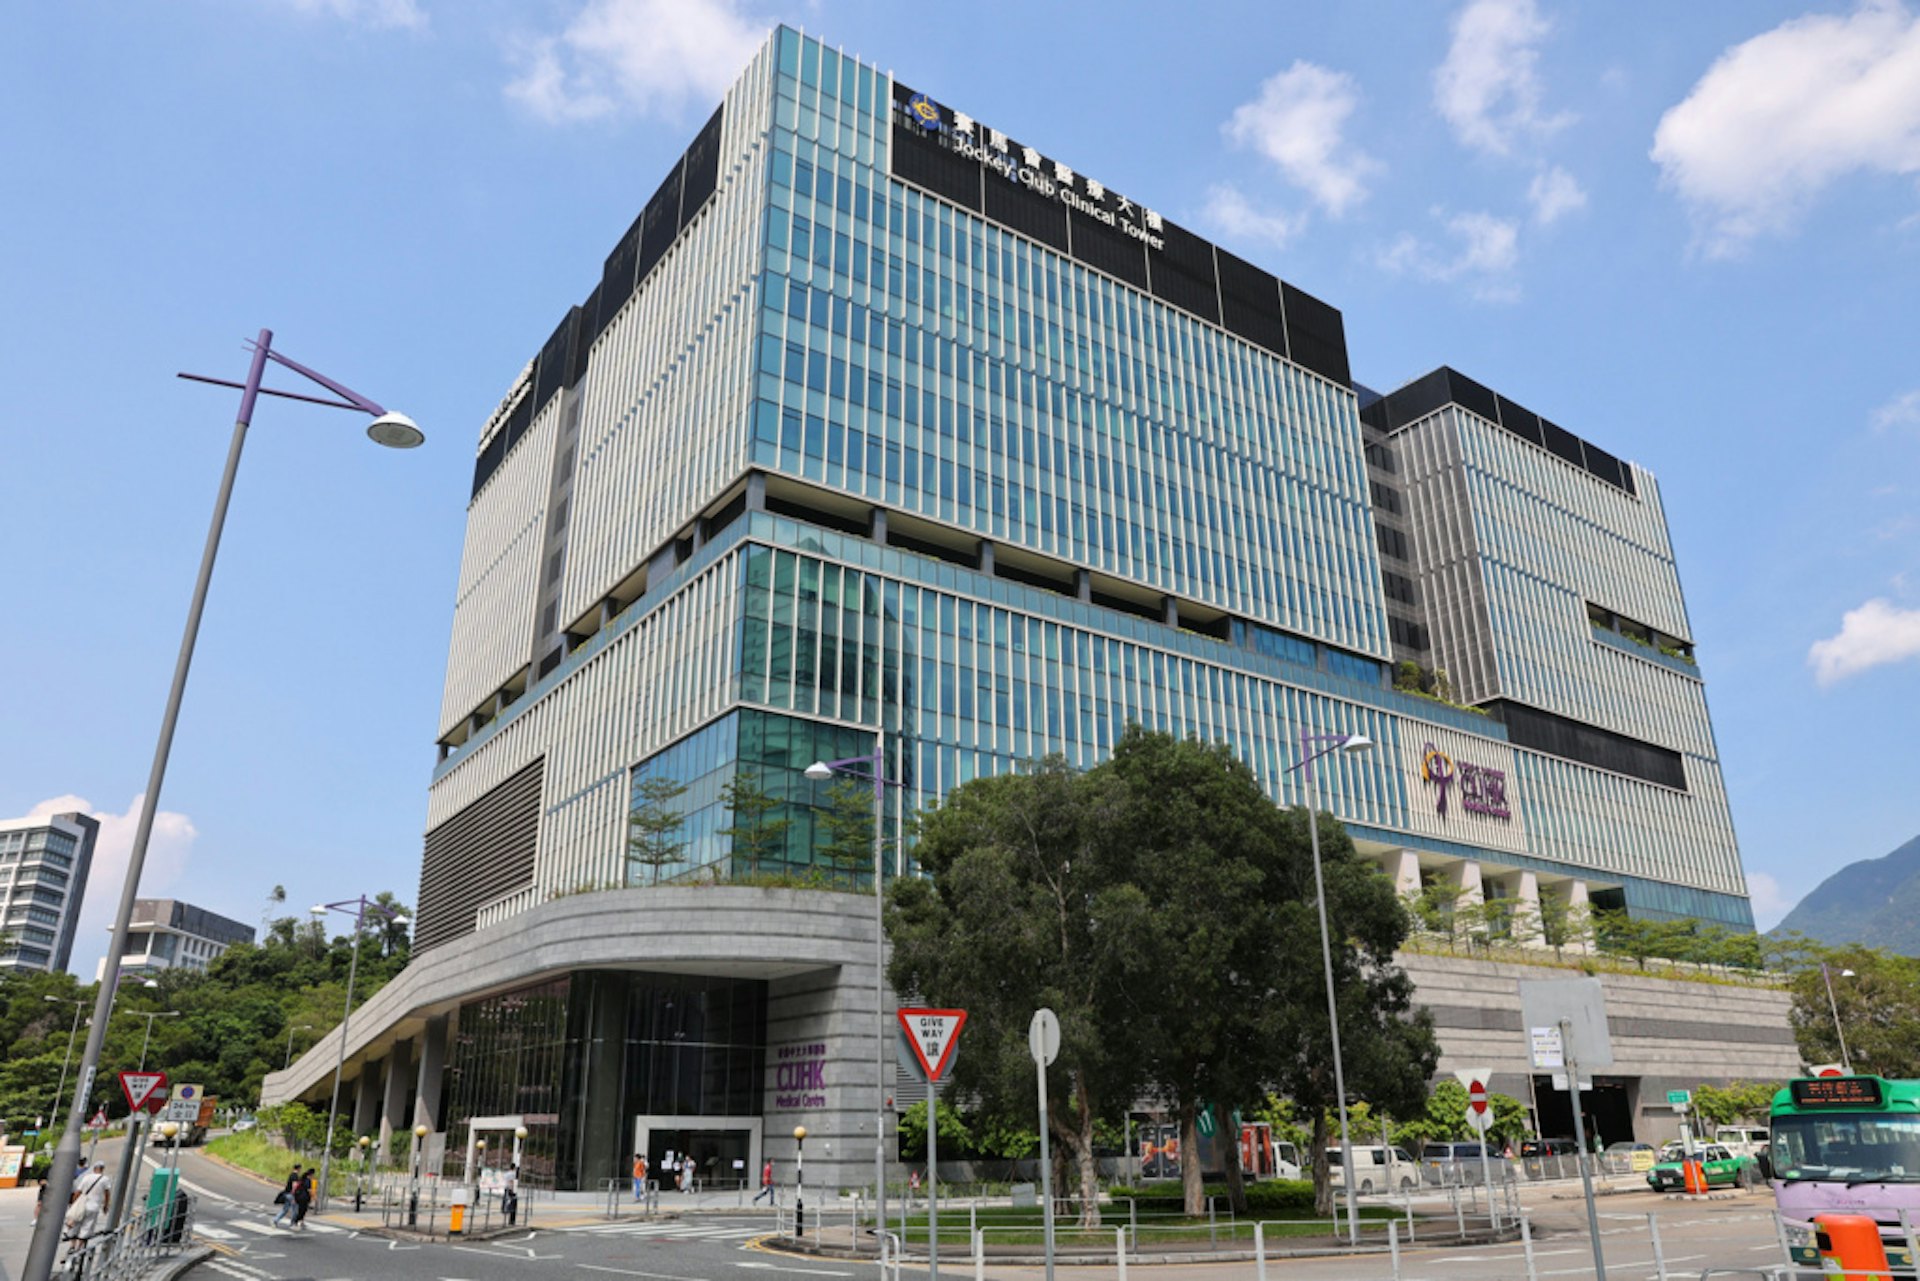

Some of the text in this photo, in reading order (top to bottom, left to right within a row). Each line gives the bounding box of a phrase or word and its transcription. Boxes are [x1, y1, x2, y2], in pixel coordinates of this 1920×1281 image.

[952, 135, 1165, 251] Jockey Club Clinical Tower
[920, 1017, 944, 1027] GIVE
[921, 1029, 944, 1038] WAY
[776, 1060, 826, 1091] CUHK
[776, 1093, 826, 1108] Medical Centre
